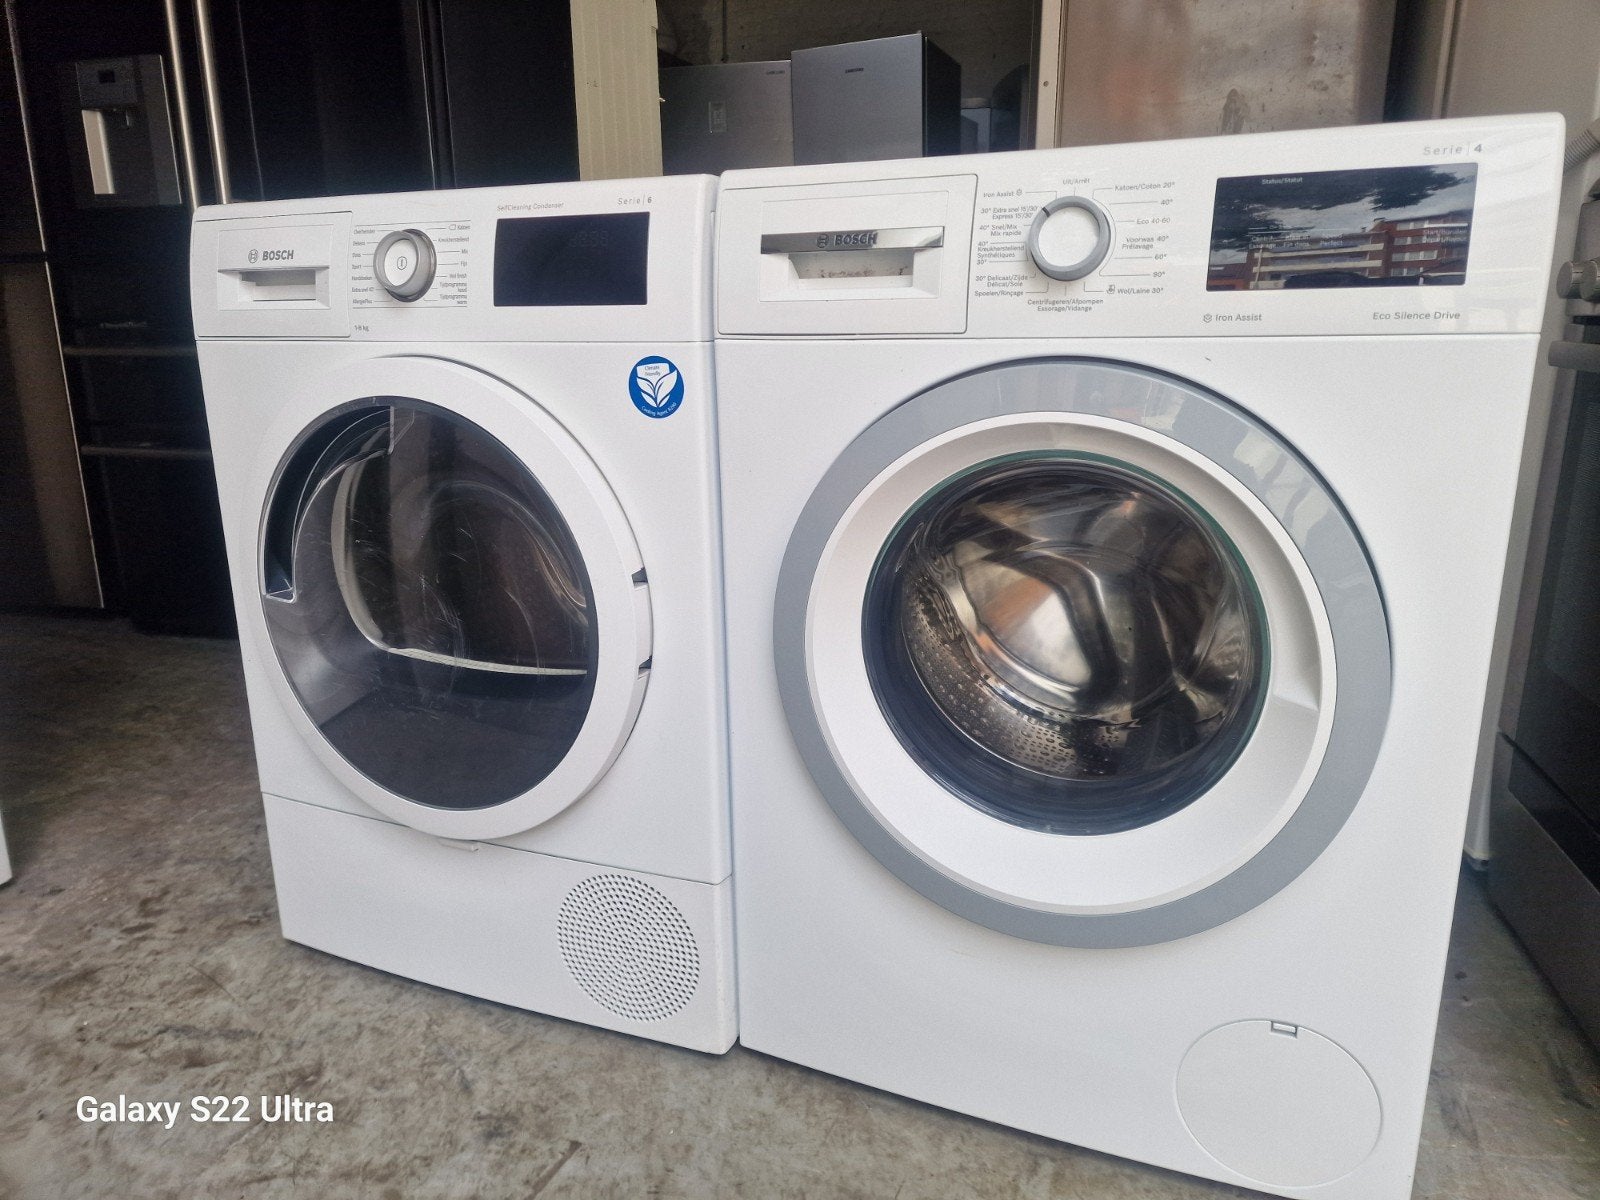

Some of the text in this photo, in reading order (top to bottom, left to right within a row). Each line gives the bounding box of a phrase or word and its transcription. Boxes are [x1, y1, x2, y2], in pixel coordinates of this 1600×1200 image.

[1423, 143, 1483, 156] Serie 4
[1114, 181, 1175, 192] Katoen/Coton 20°
[617, 196, 642, 206] Serie
[497, 202, 565, 211] SelfCleaning Condenser
[834, 231, 878, 247] BOSCH
[261, 249, 294, 261] BOSCH
[1154, 253, 1167, 261] 60°
[1117, 287, 1151, 295] Wol/Laine
[1027, 298, 1104, 306] Centrifugeren/Afpompen
[1214, 313, 1262, 322] Iron Assist
[1372, 311, 1461, 320] Eco Silence Drive
